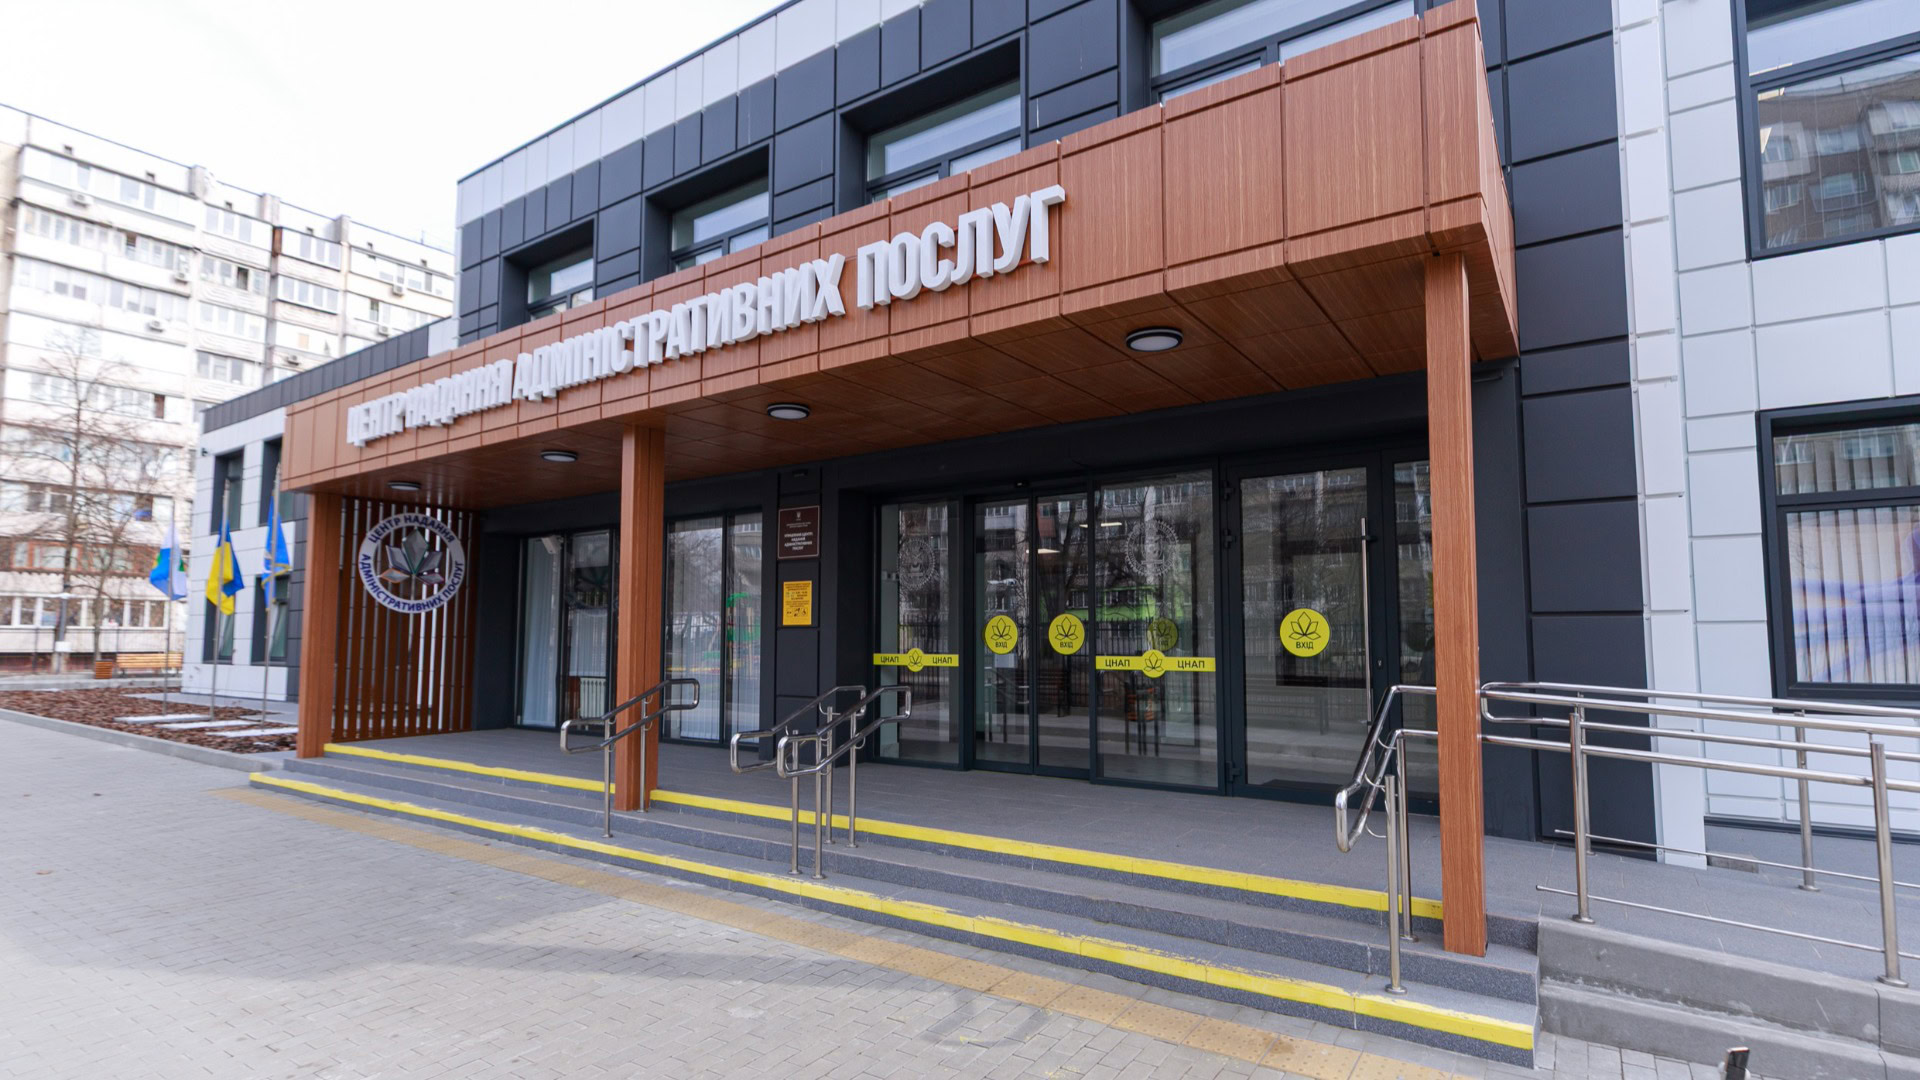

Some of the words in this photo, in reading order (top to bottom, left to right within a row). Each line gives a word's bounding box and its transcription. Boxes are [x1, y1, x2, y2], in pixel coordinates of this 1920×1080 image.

[346, 391, 407, 448] ЦЕНТР
[405, 358, 514, 428] НАДАННЯ
[512, 252, 847, 402] АДМІНІСТРАТИВНИХ
[857, 183, 1066, 311] ПОСЛУГ
[368, 517, 401, 544] ЦЕНТР
[403, 515, 456, 543] НАДАННЯ
[360, 553, 445, 612] АДМІНІСТРАТИВНИХ
[443, 560, 464, 598] ПОСЛУГ
[1059, 641, 1074, 649] ВХІД
[1295, 641, 1314, 650] ВХІД
[880, 656, 899, 664] ЦНАП
[932, 656, 953, 664] ЦНАП
[1105, 658, 1131, 668] ЦНАП
[1177, 659, 1205, 669] ЦНАП
